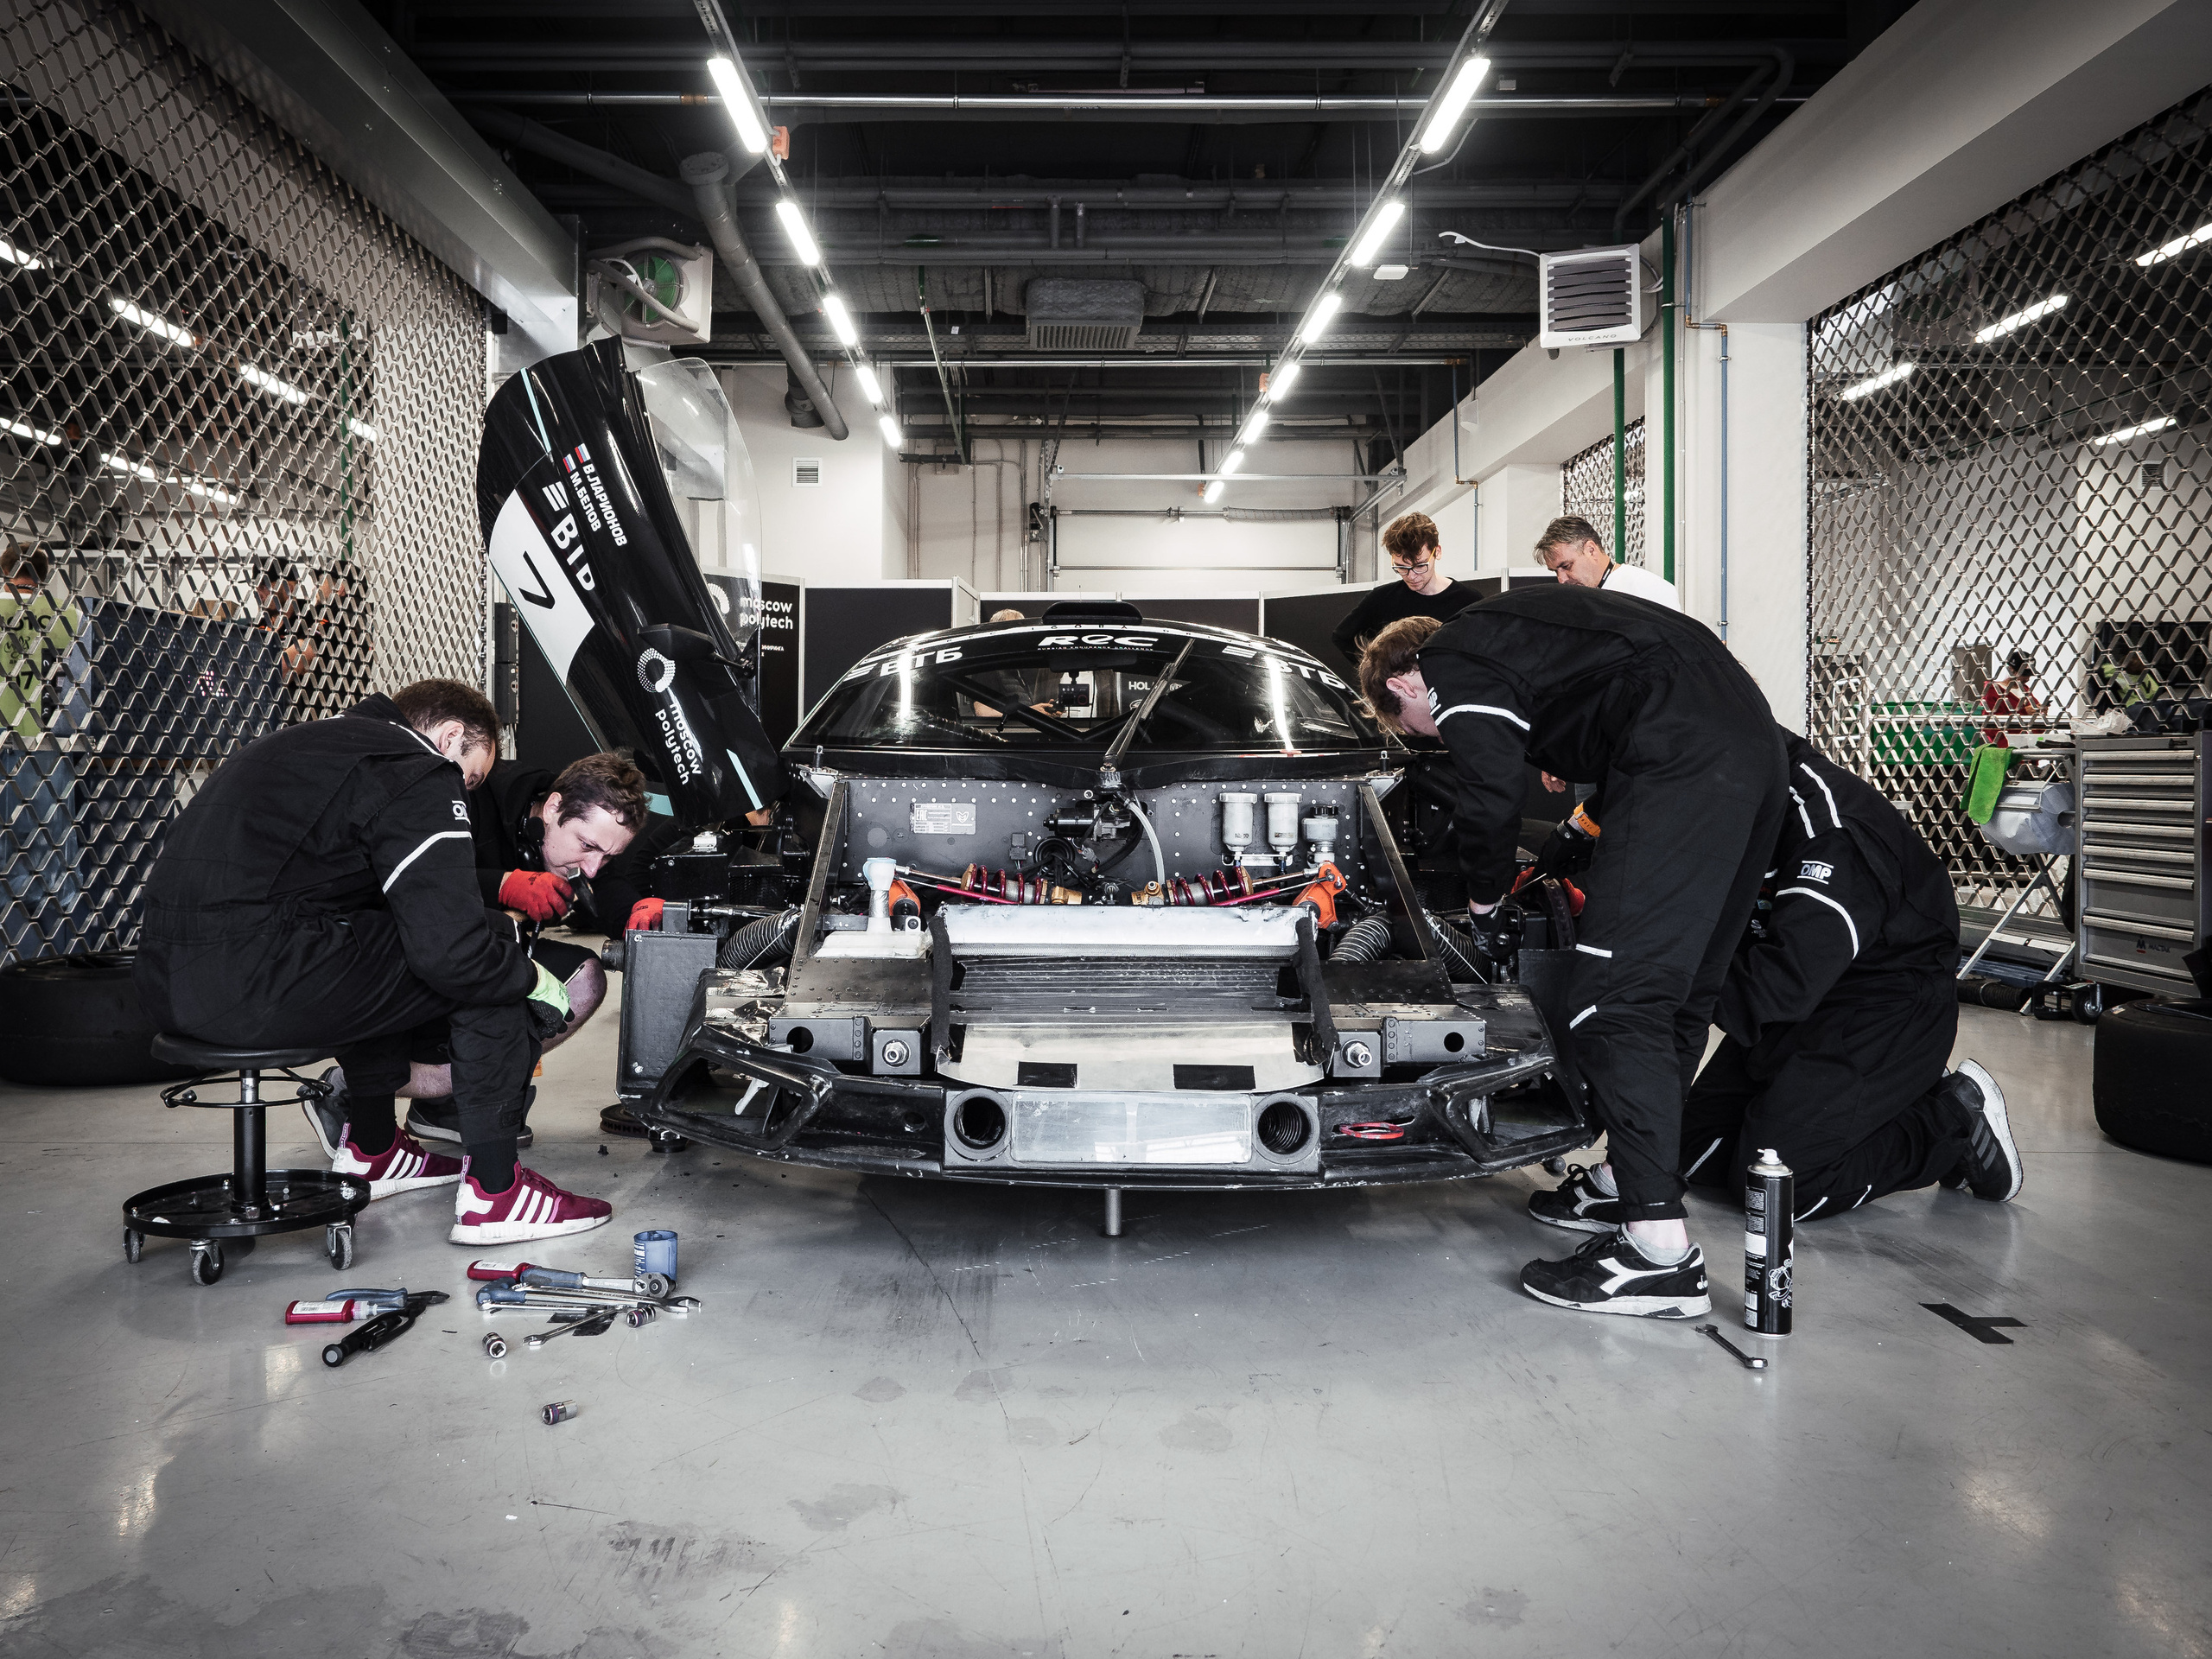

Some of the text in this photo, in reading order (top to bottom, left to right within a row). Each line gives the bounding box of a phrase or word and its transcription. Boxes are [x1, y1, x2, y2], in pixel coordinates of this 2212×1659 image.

[1567, 334, 1618, 342] VOLCANO
[569, 471, 601, 532] М.БЕЛОВ
[739, 596, 793, 613] moscow
[739, 612, 793, 630] polytech
[654, 709, 690, 785] polytech
[669, 702, 702, 775] moscow
[1800, 863, 1833, 880] OMP
